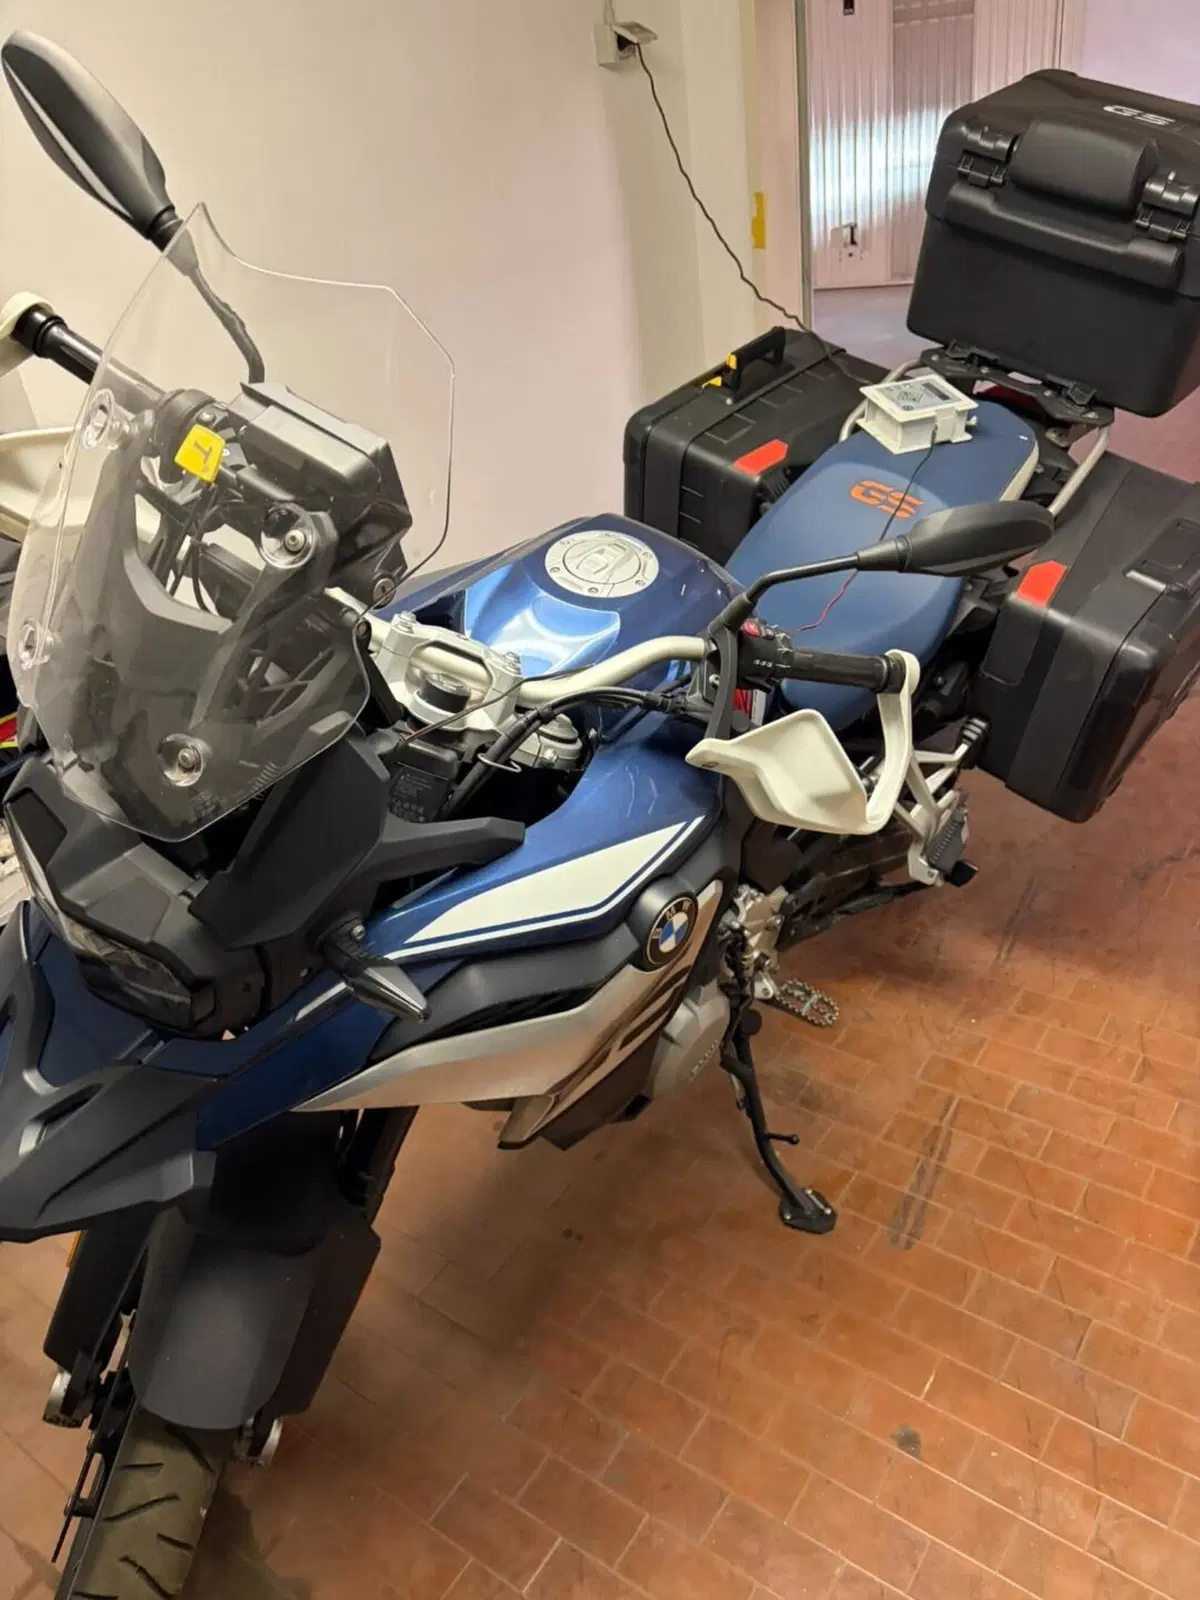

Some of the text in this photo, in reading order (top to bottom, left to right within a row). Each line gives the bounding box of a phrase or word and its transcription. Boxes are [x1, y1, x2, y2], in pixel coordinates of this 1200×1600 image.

[1102, 104, 1176, 126] GS
[849, 479, 924, 519] GS
[651, 898, 691, 939] BMW
